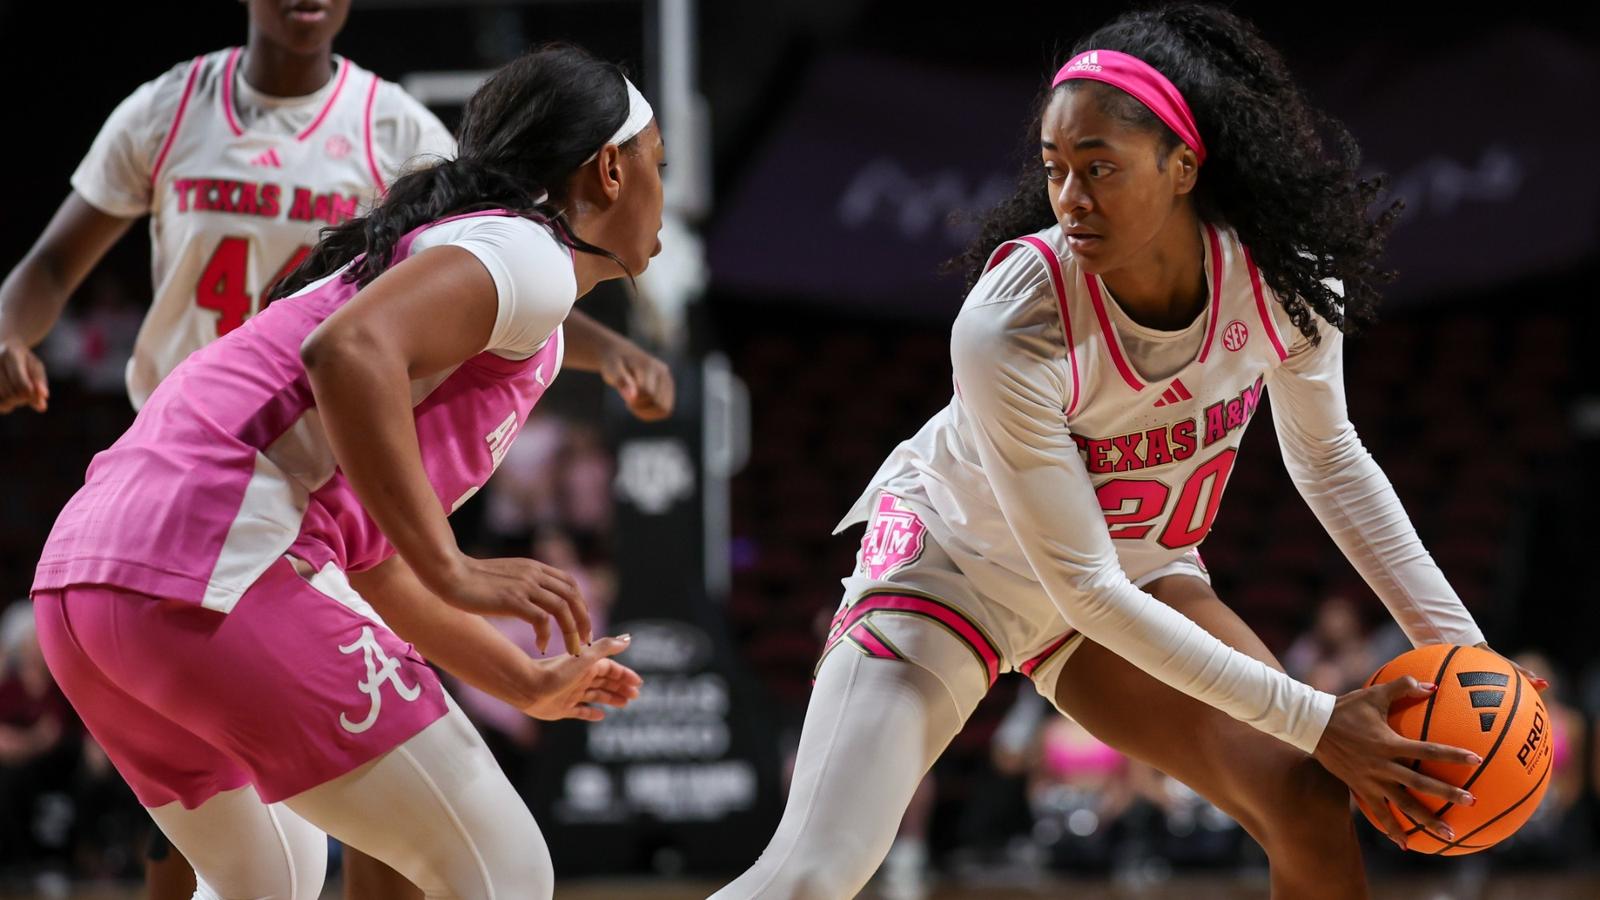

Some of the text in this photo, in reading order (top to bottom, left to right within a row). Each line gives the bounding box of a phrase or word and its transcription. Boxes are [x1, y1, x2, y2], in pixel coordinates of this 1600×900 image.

[173, 177, 281, 218] TEXAS
[1223, 322, 1247, 351] SEC
[1202, 373, 1264, 449] A&M
[1095, 447, 1238, 550] 20
[338, 626, 421, 733] A
[1516, 700, 1545, 767] PRO 1
